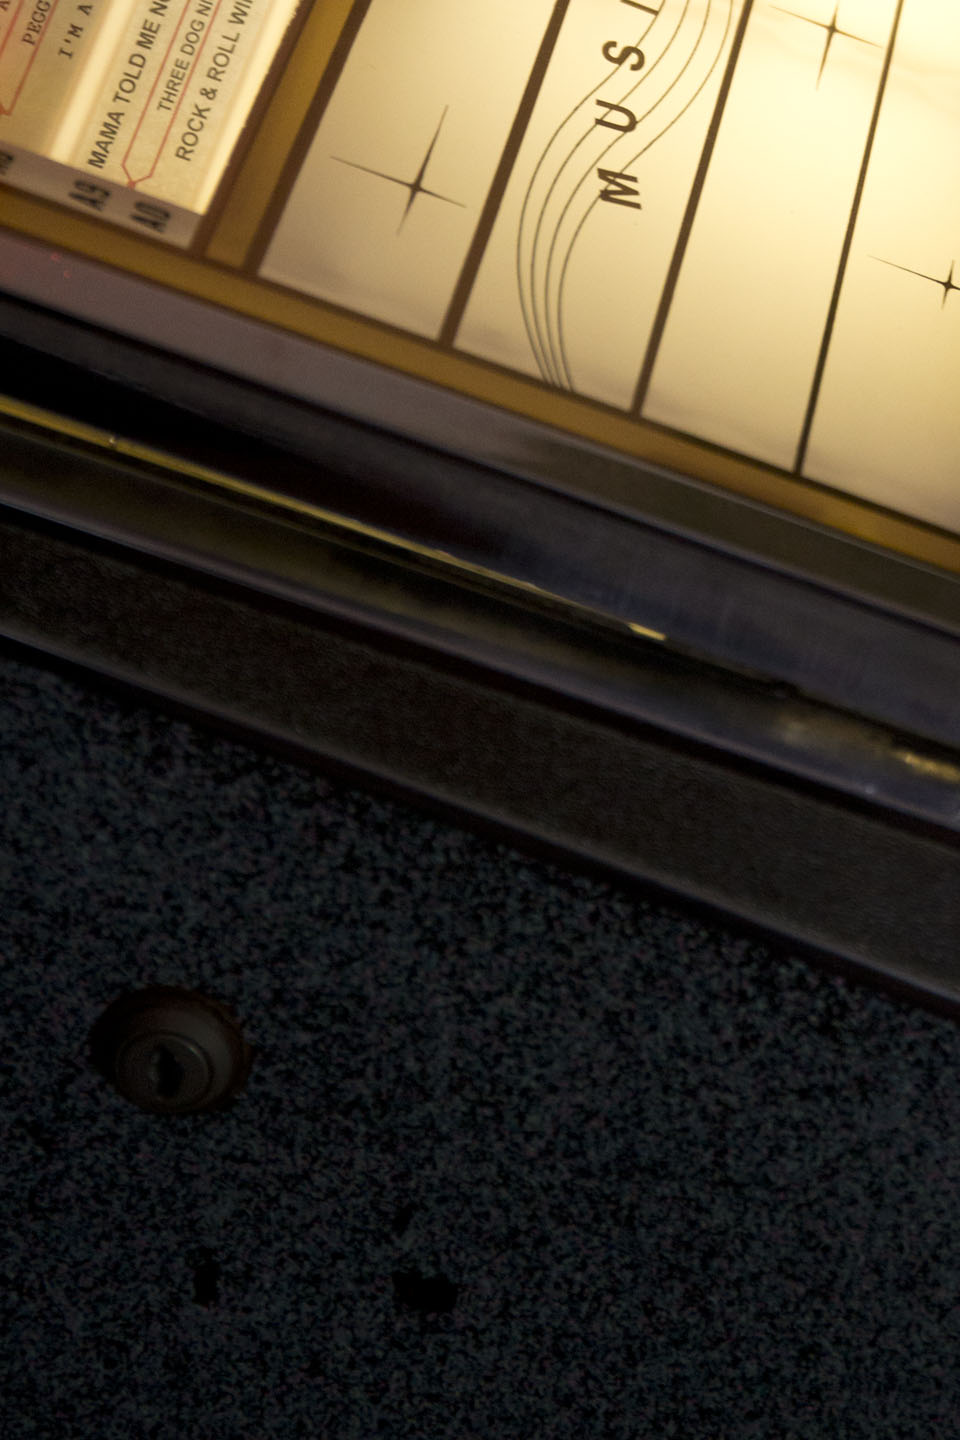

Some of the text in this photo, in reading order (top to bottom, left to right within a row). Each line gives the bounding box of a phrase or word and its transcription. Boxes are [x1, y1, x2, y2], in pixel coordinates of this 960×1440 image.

[58, 24, 84, 60] I'M
[77, 3, 93, 17] A
[206, 32, 241, 82] ROLL
[87, 111, 126, 169] MAMA
[112, 52, 147, 103] TOLD
[136, 19, 161, 50] ME
[157, 58, 190, 112] THREE
[180, 19, 206, 56] DOG
[200, 88, 218, 101] &
[175, 104, 211, 162] ROCK
